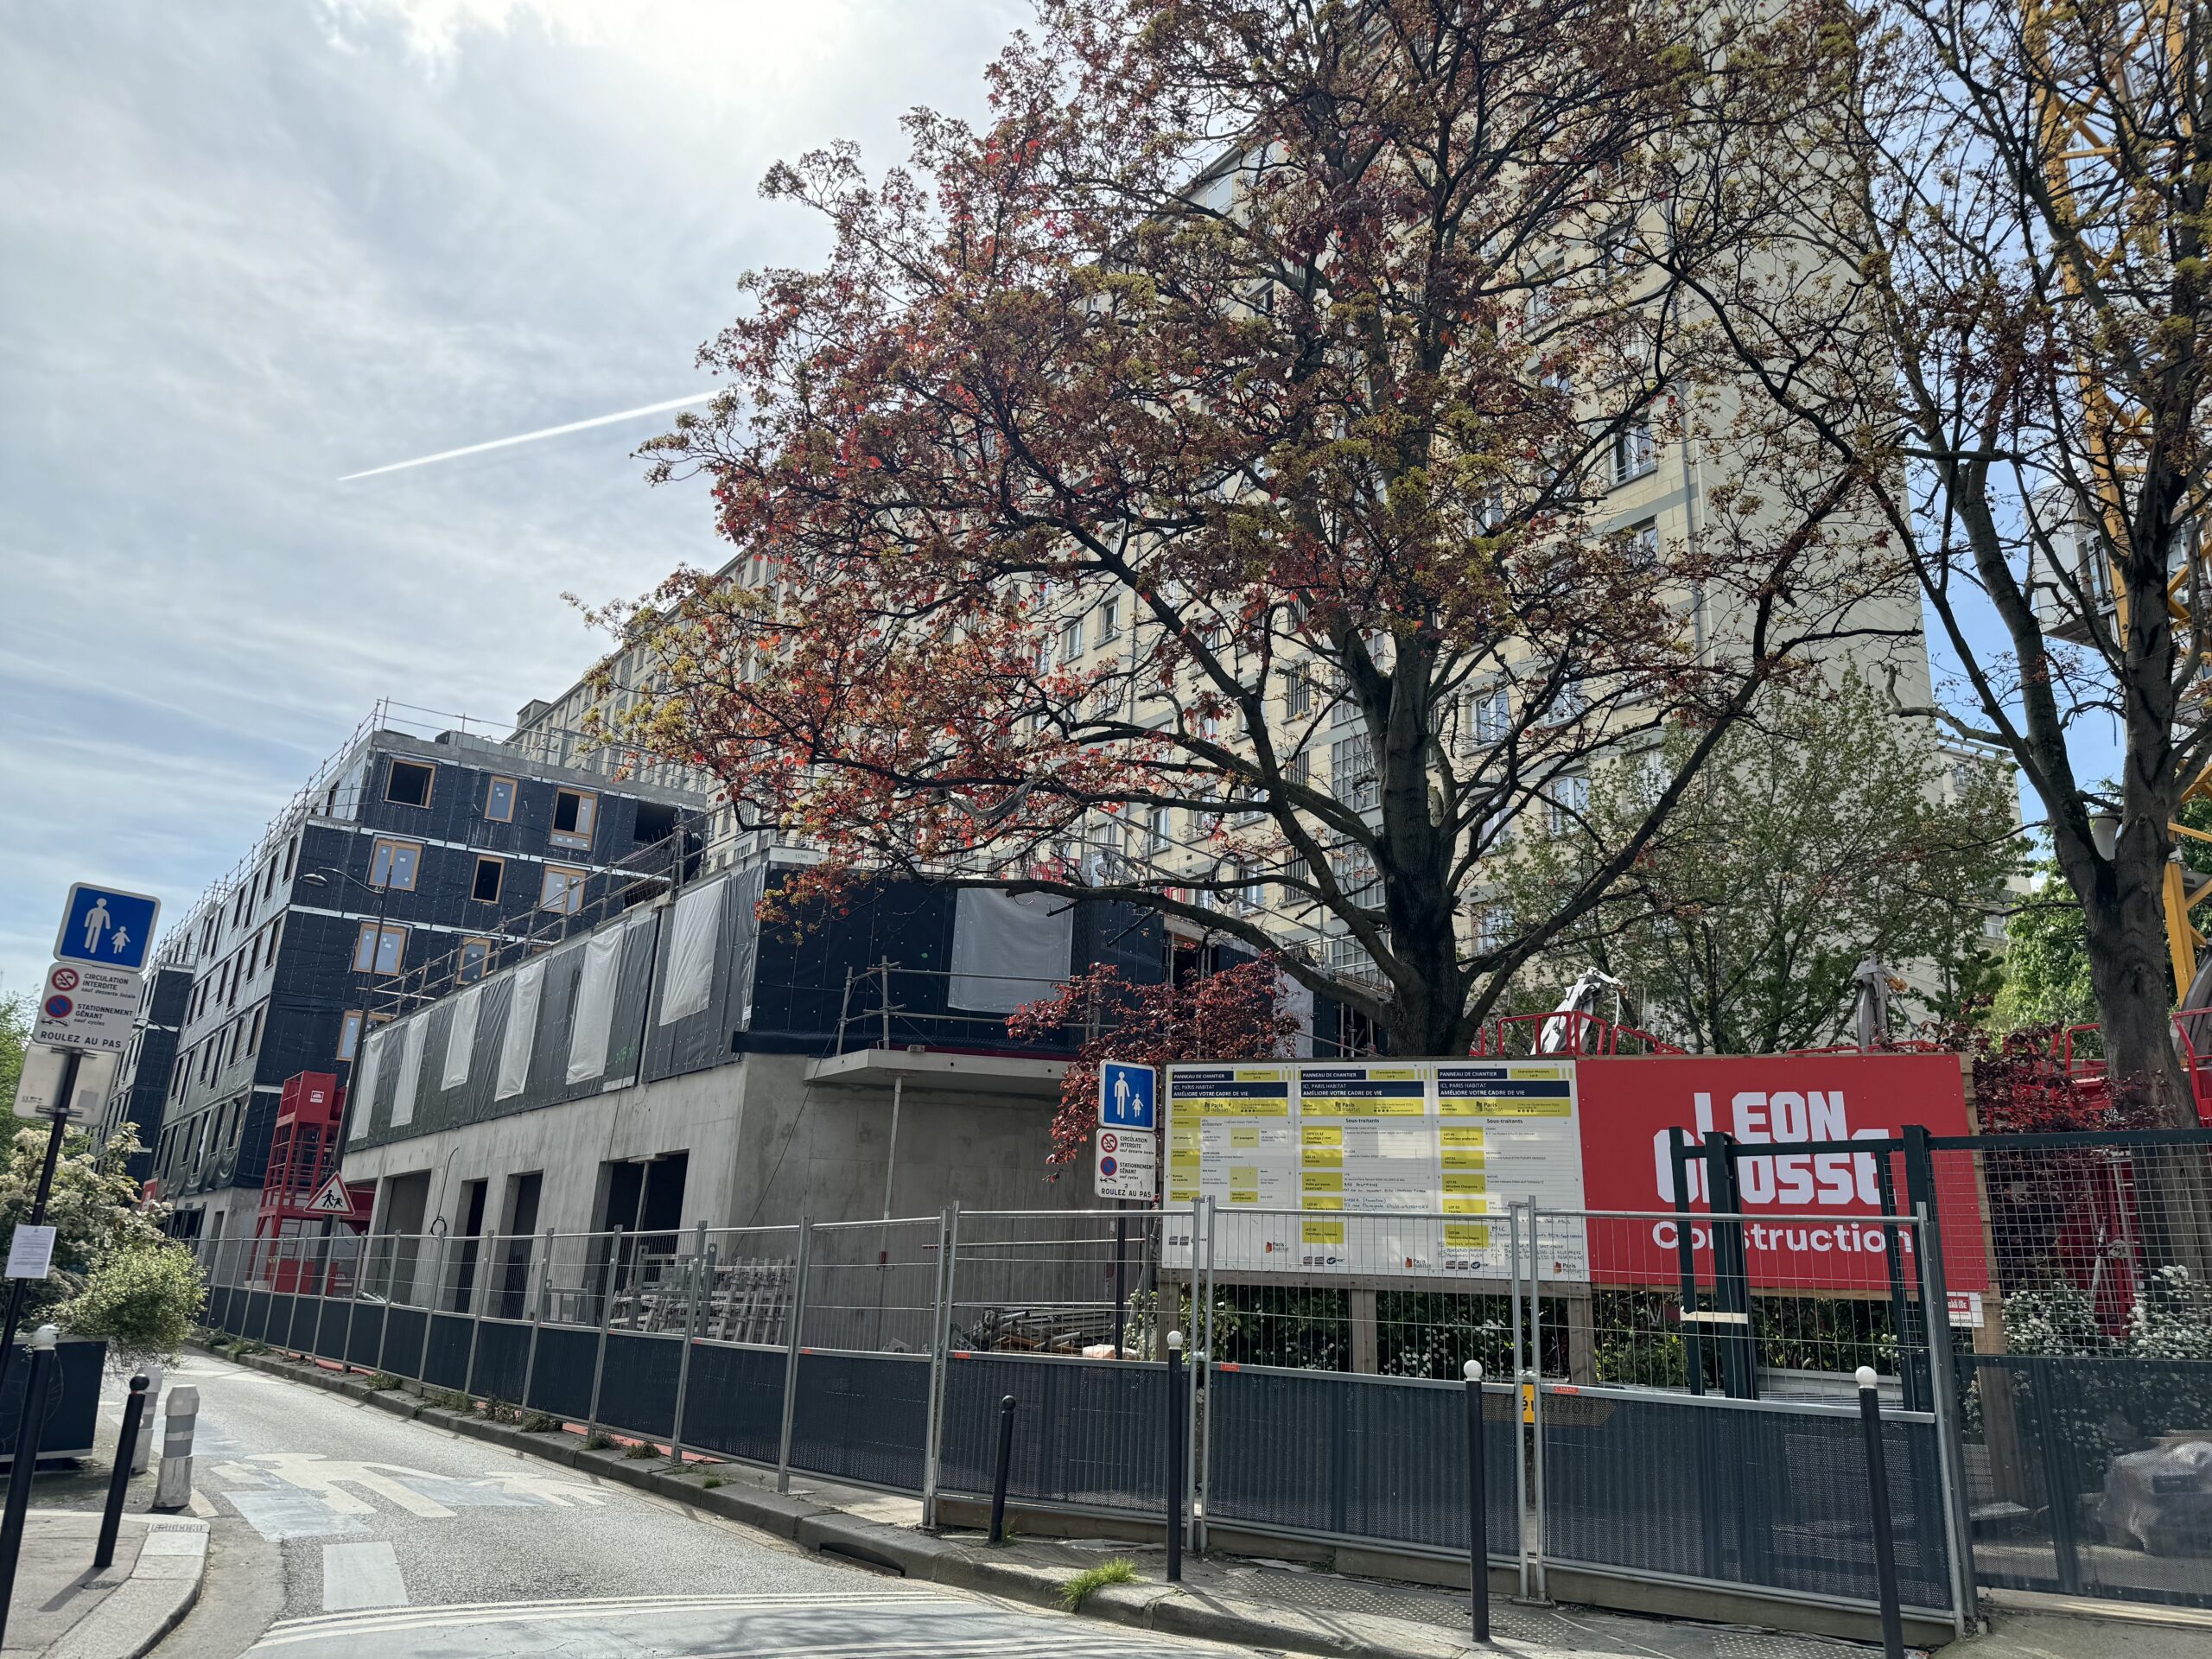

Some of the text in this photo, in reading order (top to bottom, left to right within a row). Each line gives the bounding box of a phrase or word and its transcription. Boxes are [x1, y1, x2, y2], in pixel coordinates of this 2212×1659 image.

[82, 980, 118, 990] INTERDITE
[84, 973, 129, 984] CIRCULATION
[75, 1010, 104, 1019] GÊNANT
[77, 1003, 133, 1016] STATIONNEMENT
[40, 1031, 122, 1048] ROULEZ AU PAS
[1694, 1090, 1847, 1146] LEON
[1653, 1128, 1897, 1205] GOSSE
